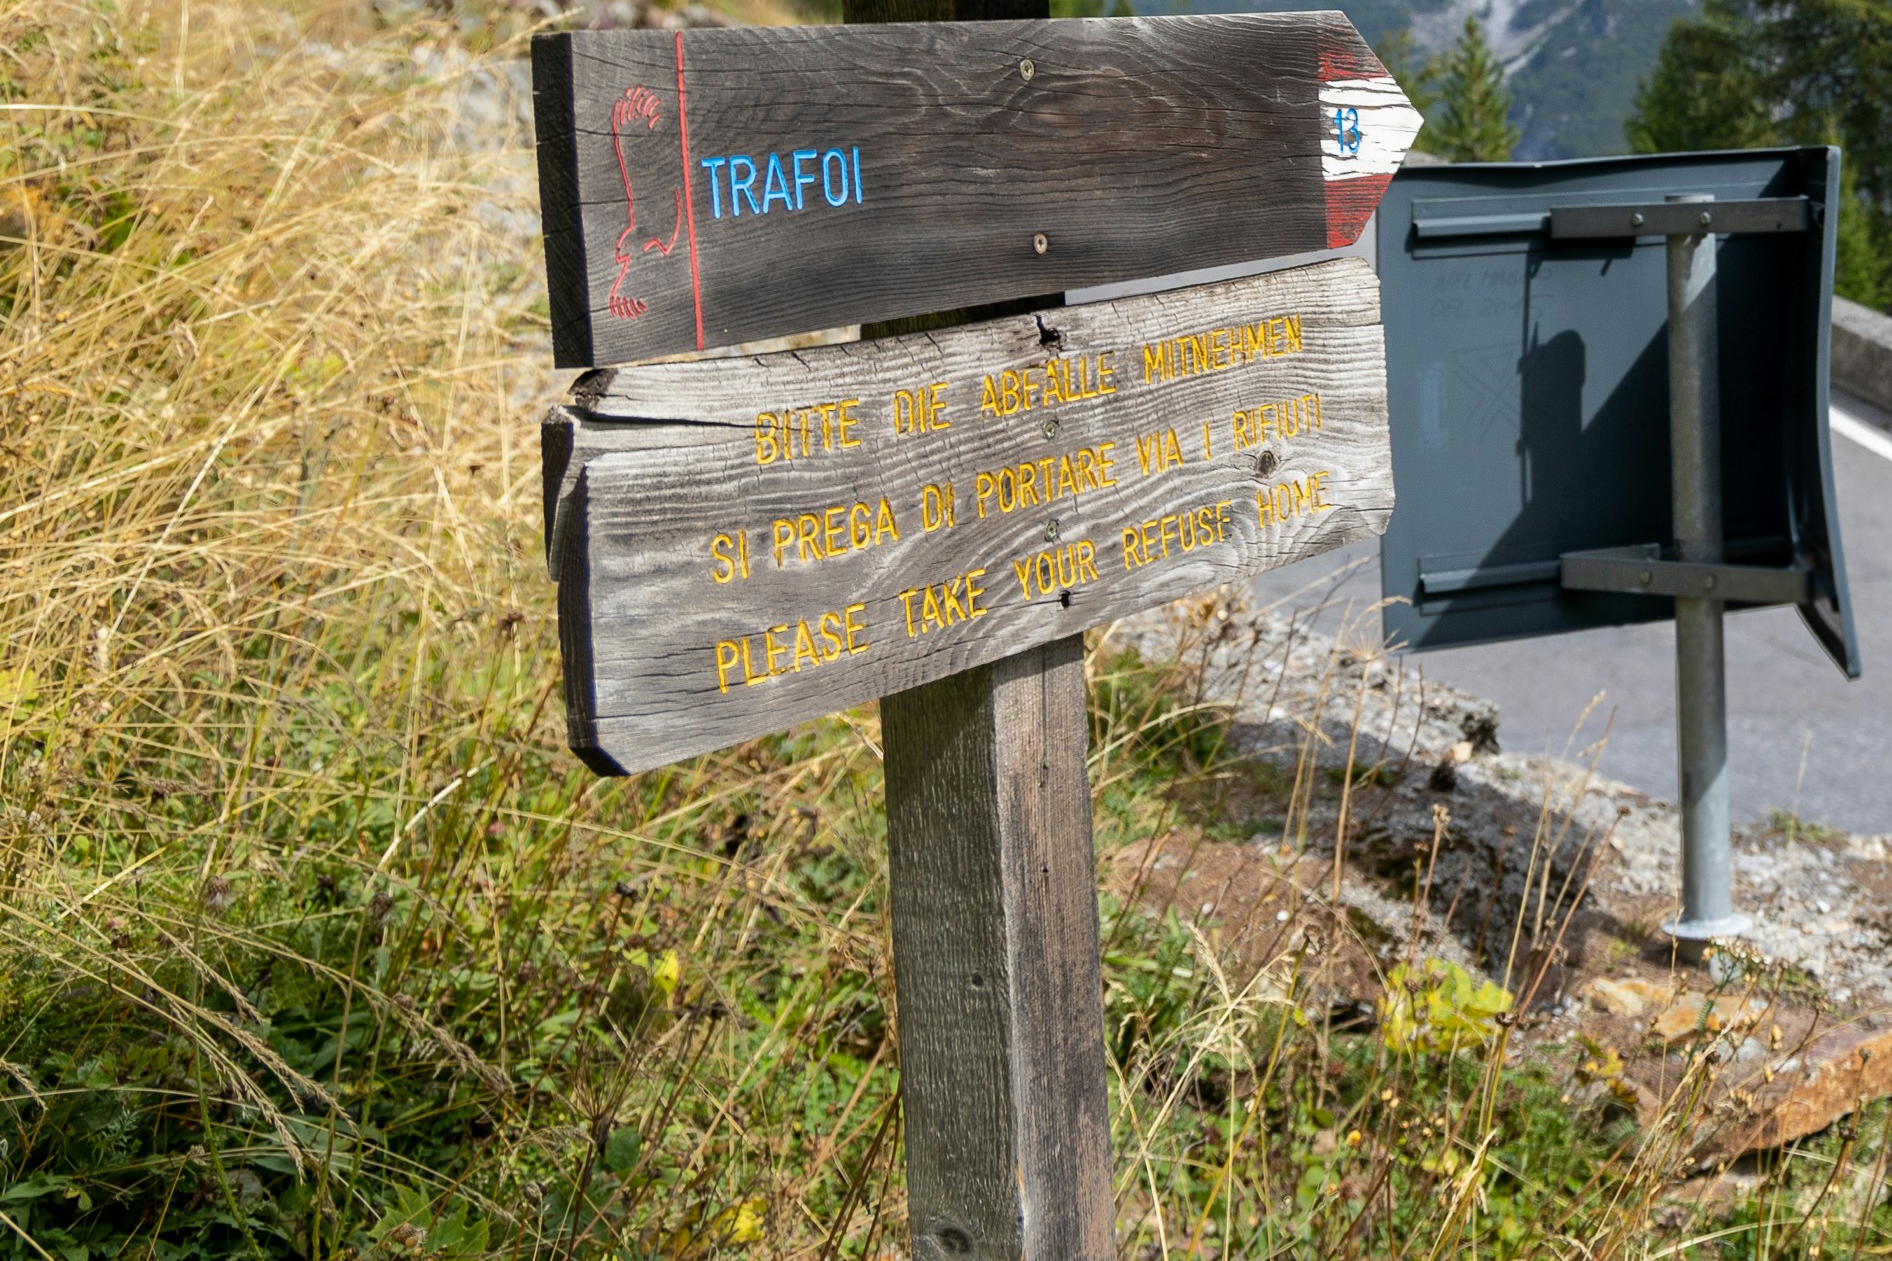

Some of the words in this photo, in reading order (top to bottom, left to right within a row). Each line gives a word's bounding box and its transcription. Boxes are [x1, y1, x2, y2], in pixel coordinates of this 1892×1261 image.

[698, 144, 865, 219] TRAFOI
[1332, 106, 1362, 155] 13
[753, 398, 863, 465] BITTE
[892, 380, 952, 435] DIE
[1142, 314, 1303, 384] MITNEHMEN
[710, 528, 751, 584] SI
[771, 497, 901, 564] PREGA
[921, 481, 956, 531] DI
[974, 440, 1118, 519] PORTARE
[1134, 428, 1185, 473] VIA
[1201, 421, 1214, 462] I
[1232, 393, 1322, 450] RIFIUTI
[714, 601, 869, 695] PLEASE
[896, 567, 989, 637] TAKE
[1012, 538, 1100, 600] YOUR
[1121, 499, 1231, 570] REFUSE
[1255, 470, 1332, 527] HOME
